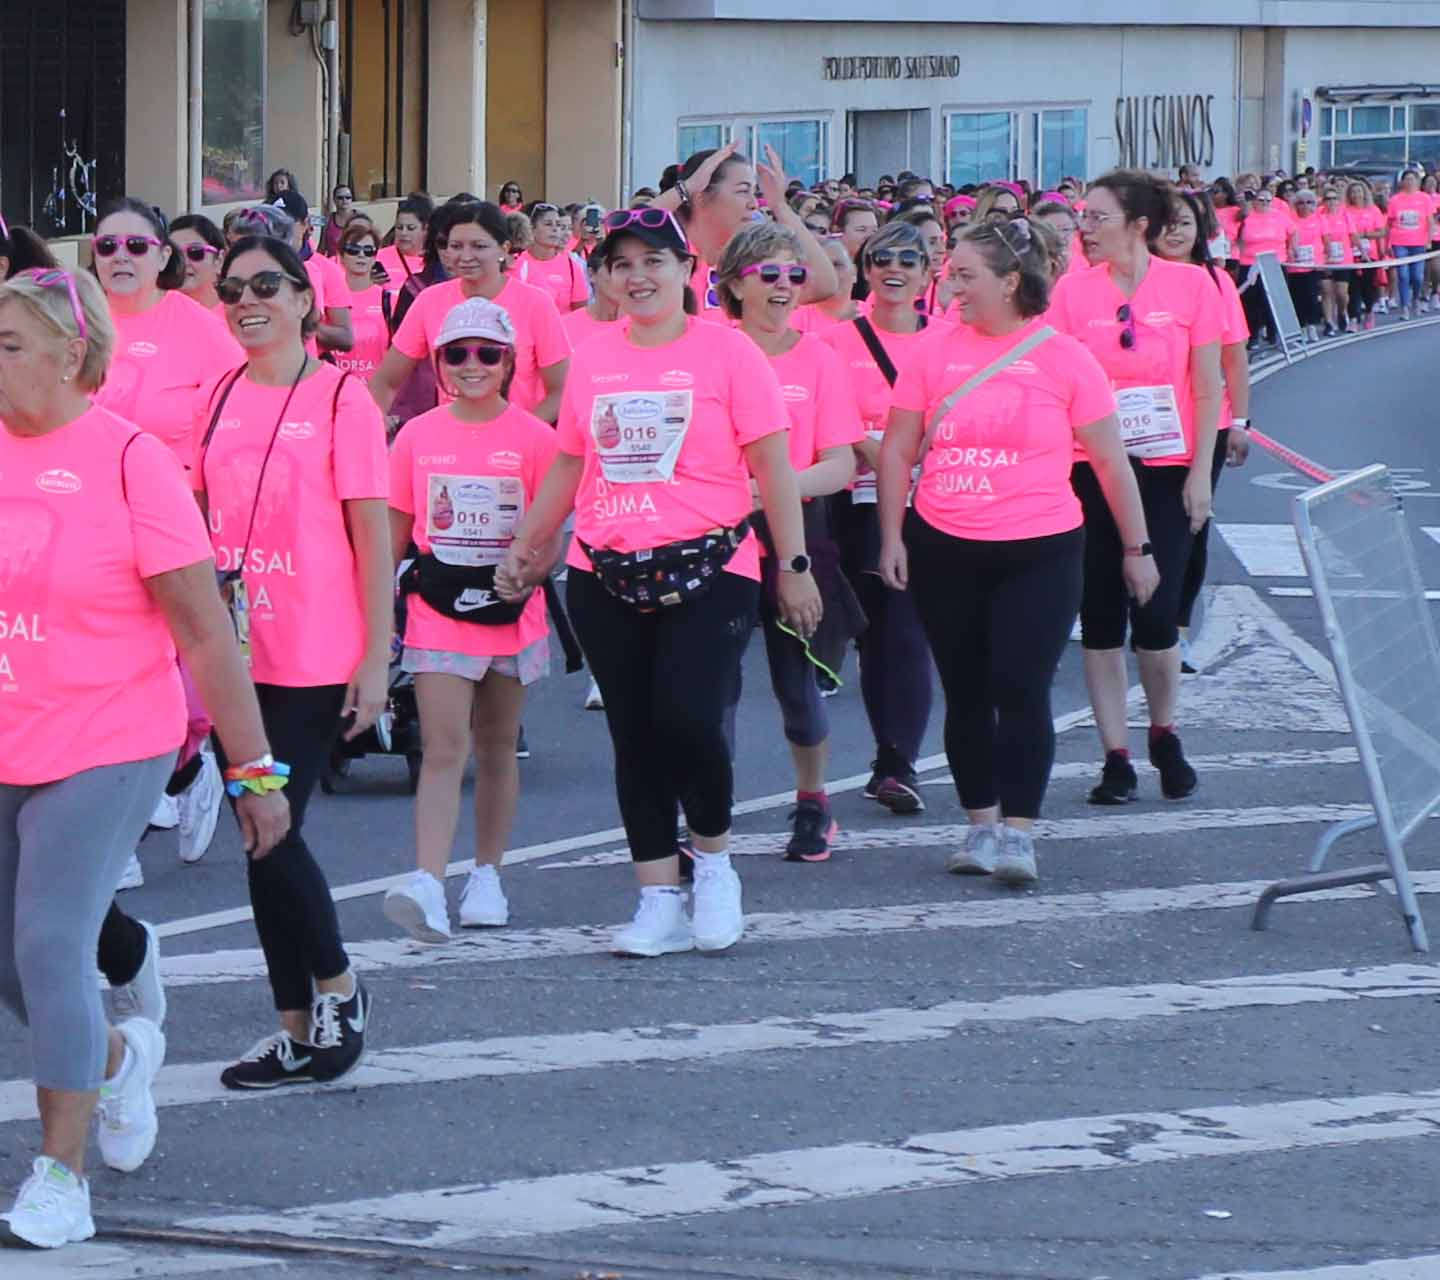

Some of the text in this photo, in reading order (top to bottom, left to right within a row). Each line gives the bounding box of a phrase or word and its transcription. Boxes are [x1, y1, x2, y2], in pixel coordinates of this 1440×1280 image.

[904, 55, 961, 79] SALESIANO
[1115, 93, 1215, 169] SALESIANOS
[624, 426, 657, 441] 016
[457, 511, 490, 526] 016
[593, 493, 657, 520] SUMA
[218, 545, 297, 577] ORSAL
